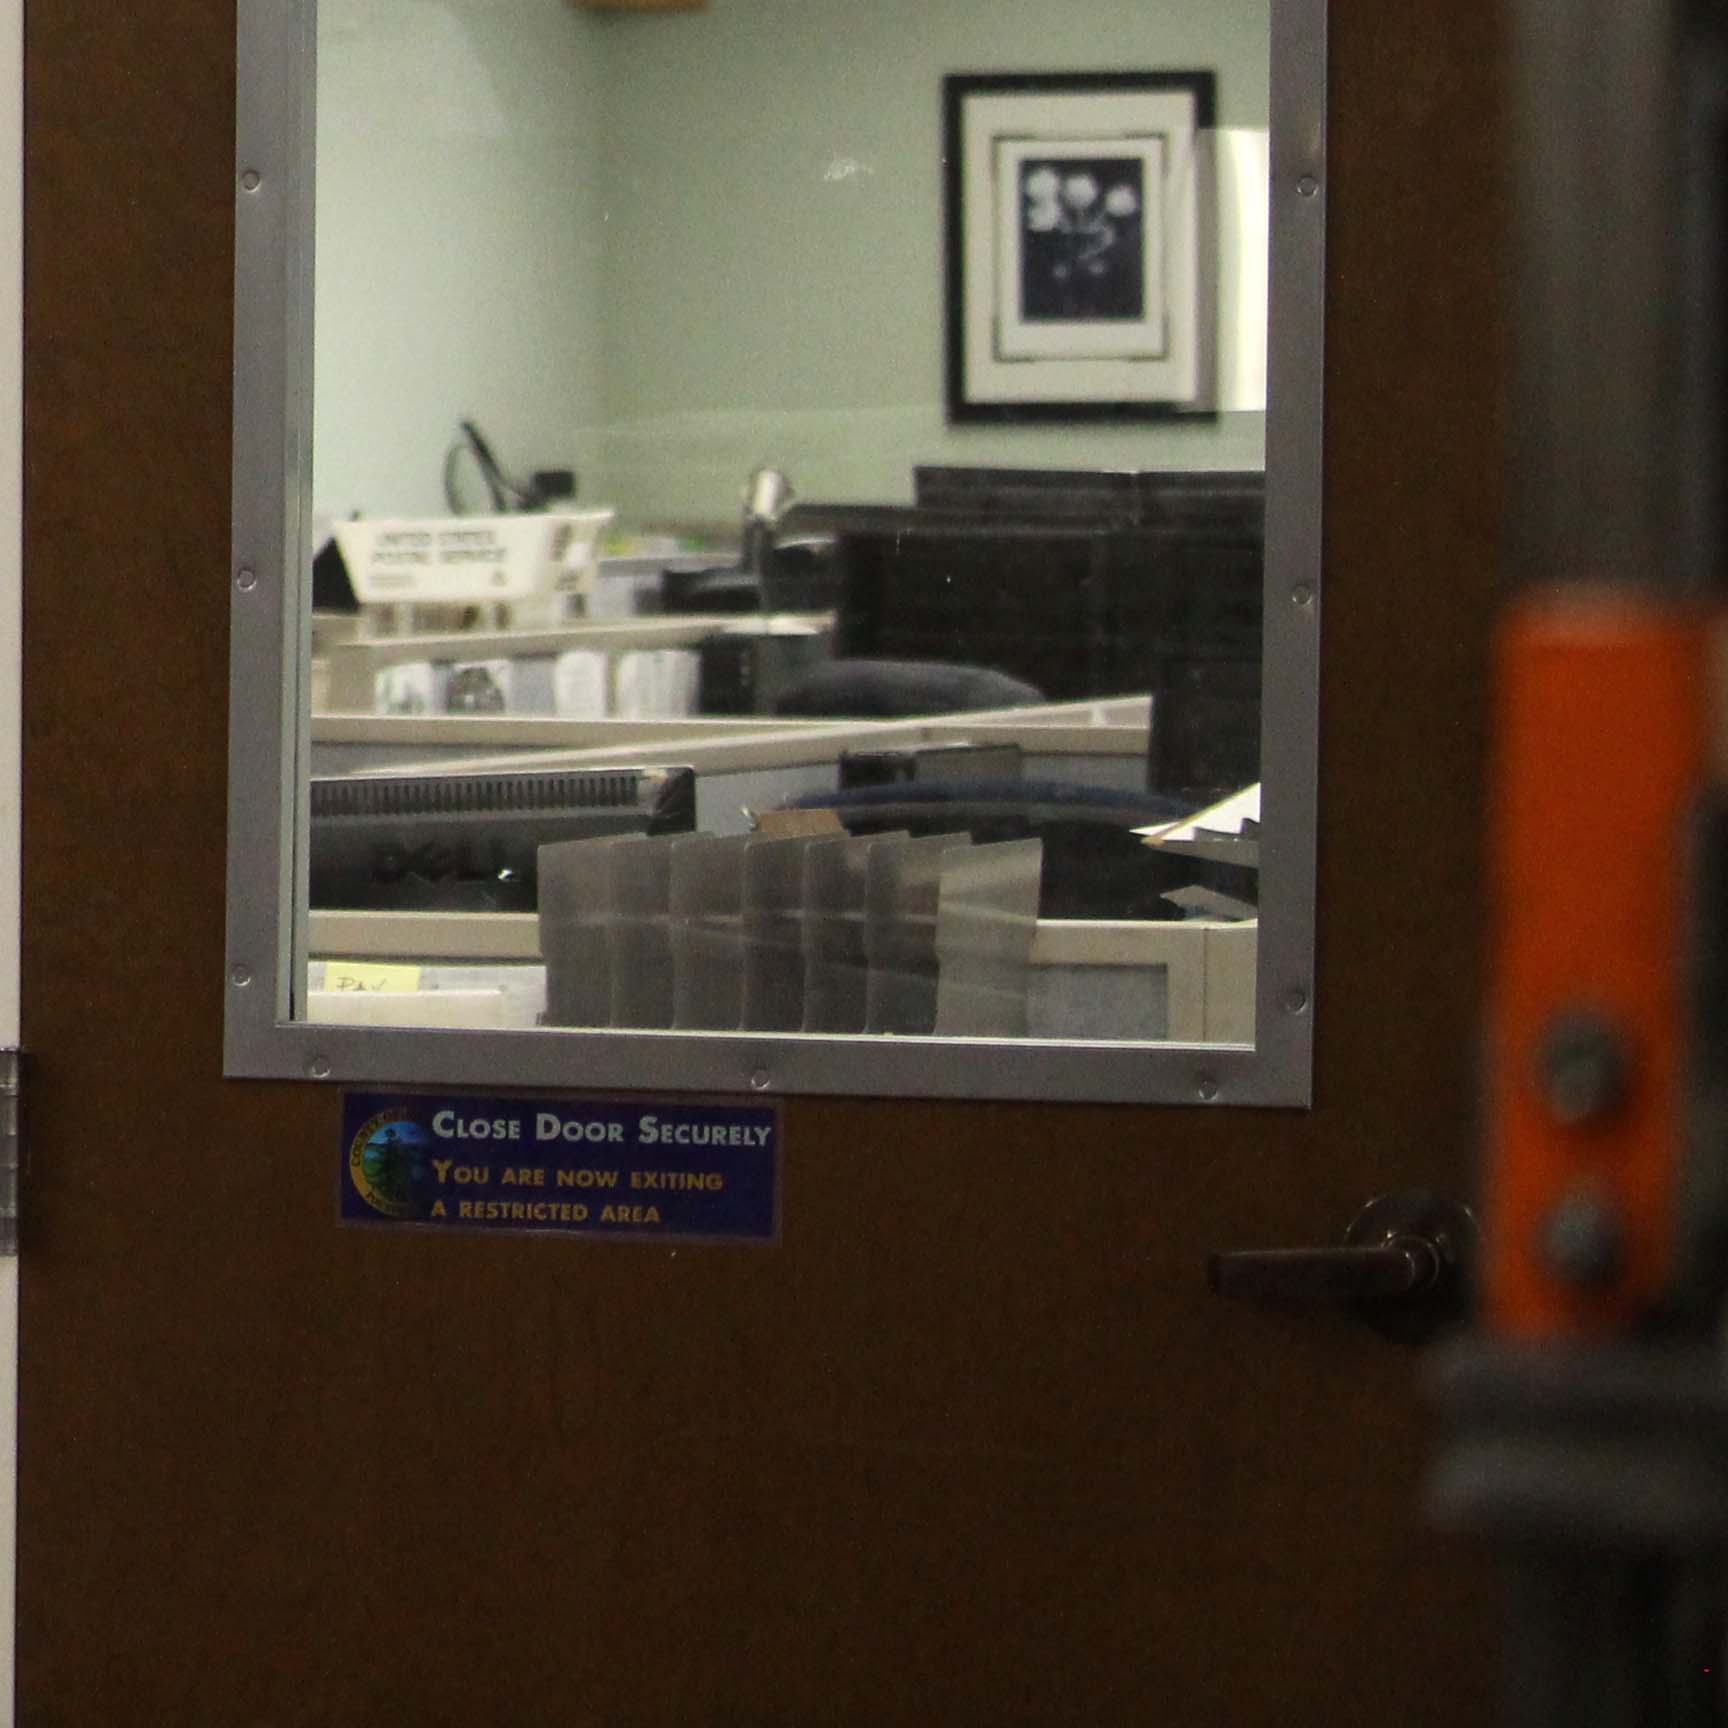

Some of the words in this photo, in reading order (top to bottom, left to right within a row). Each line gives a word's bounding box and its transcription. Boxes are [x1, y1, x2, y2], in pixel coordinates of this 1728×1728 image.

[432, 1111, 521, 1140] CLOSE
[535, 1113, 625, 1143] DOOR
[638, 1115, 773, 1147] SECURELY
[432, 1159, 490, 1186] YOU
[501, 1167, 546, 1187] ARE
[556, 1169, 619, 1189] NOW
[630, 1172, 725, 1191] EXITING
[430, 1199, 447, 1218] A
[458, 1200, 589, 1222] RESTRICTED
[600, 1203, 662, 1223] AREA
